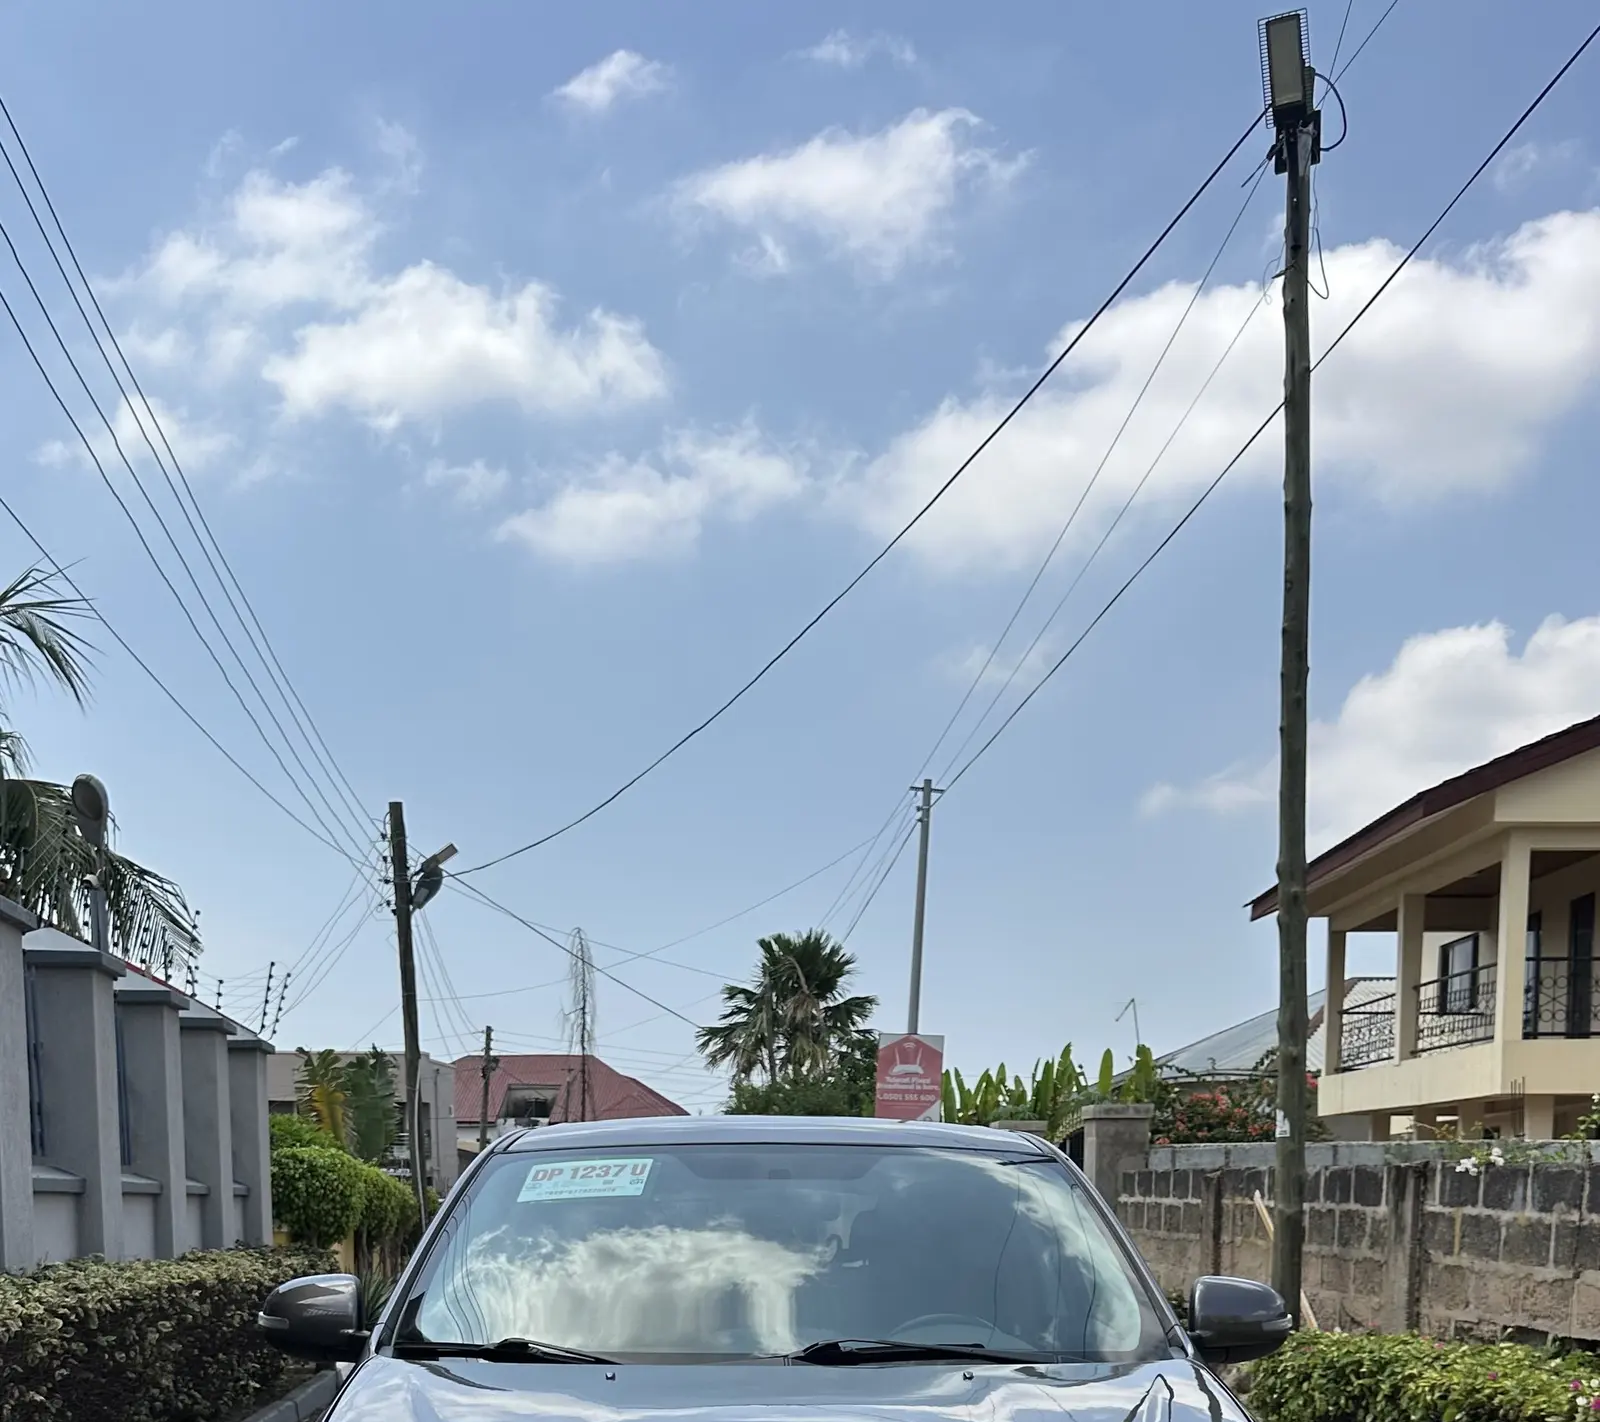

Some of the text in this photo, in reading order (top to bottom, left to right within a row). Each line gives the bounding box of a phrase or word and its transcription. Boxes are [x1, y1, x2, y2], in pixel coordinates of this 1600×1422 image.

[532, 1163, 648, 1182] DP 1237 U
